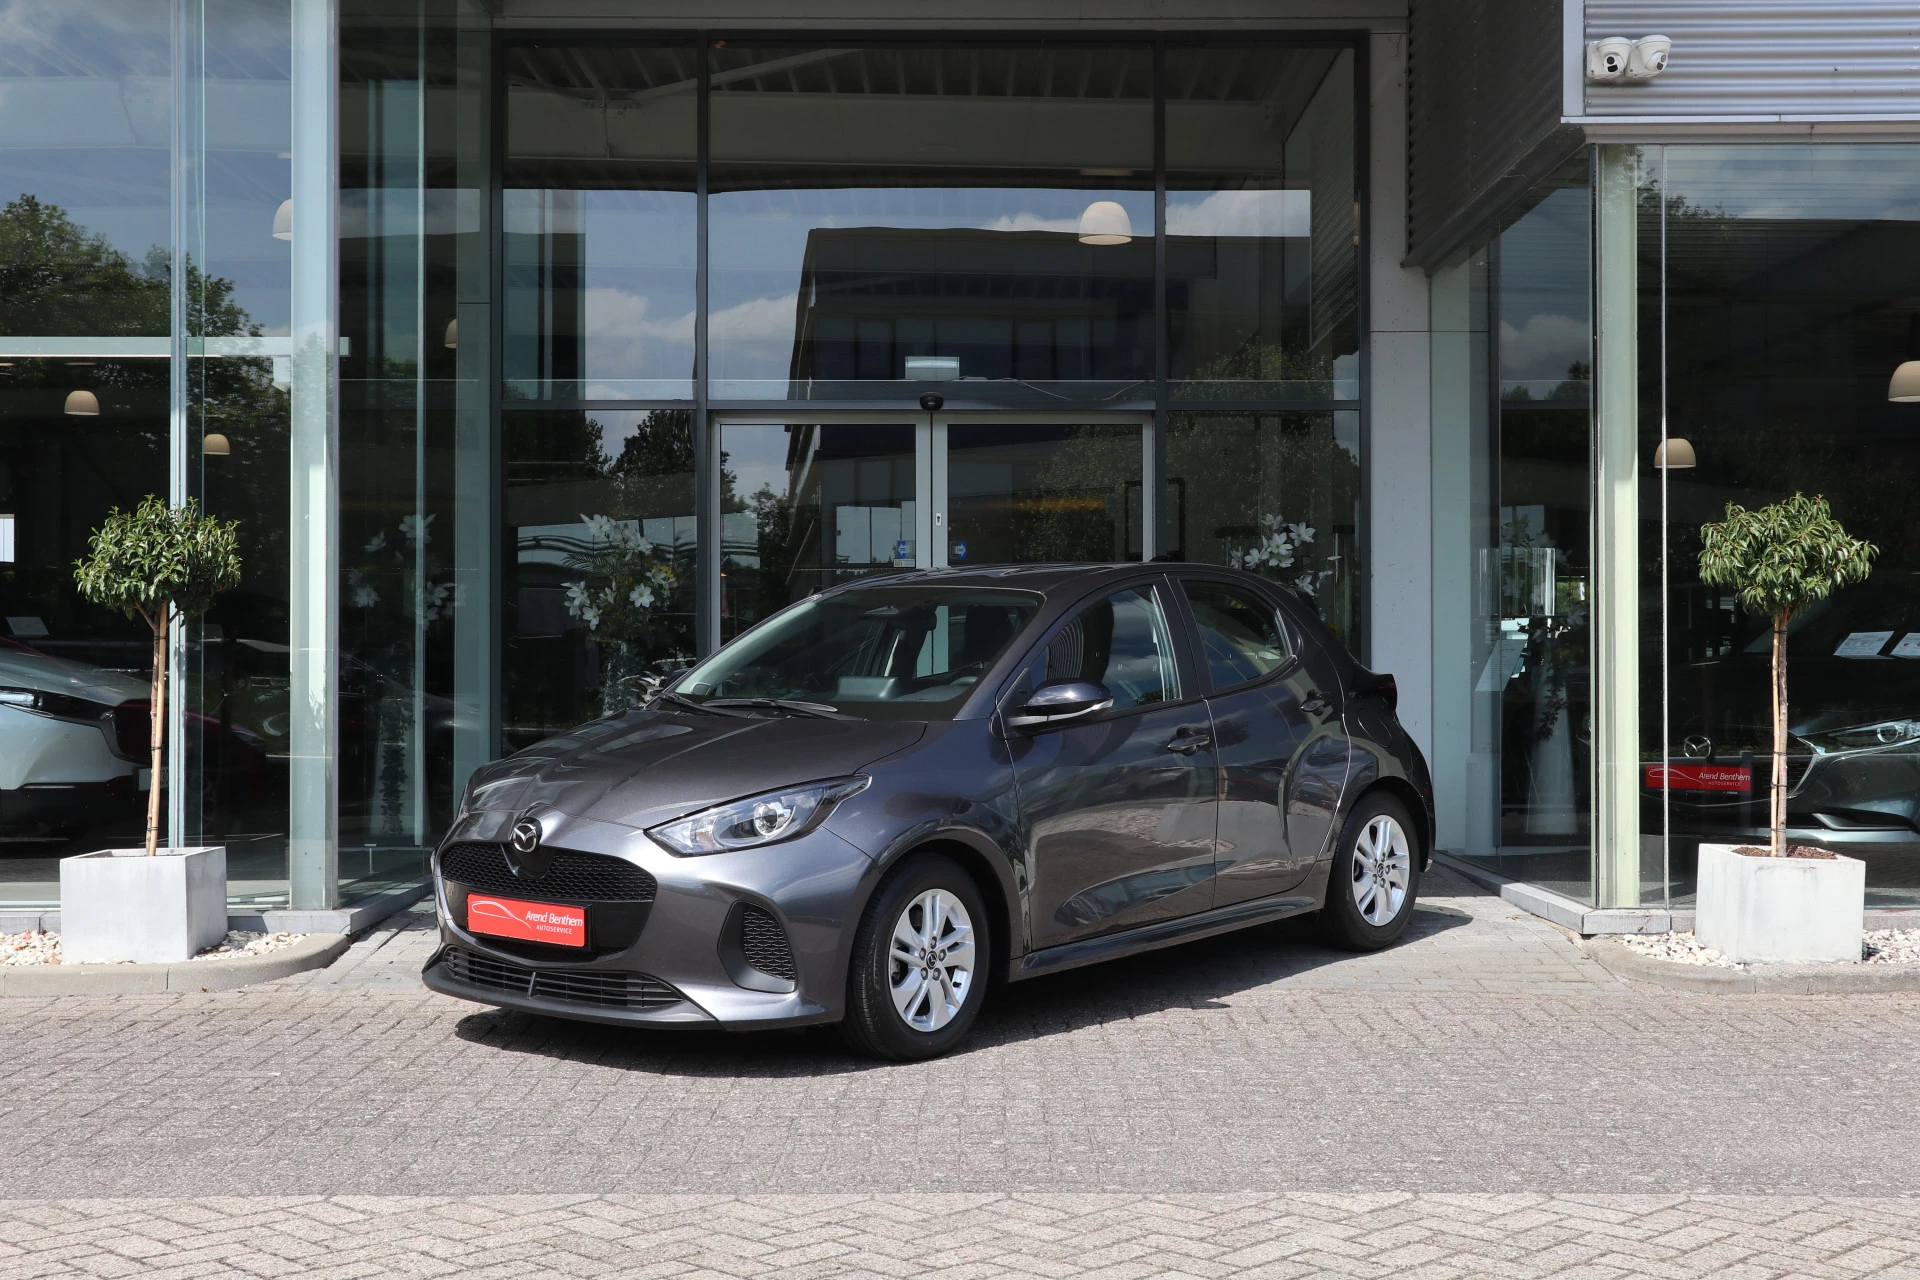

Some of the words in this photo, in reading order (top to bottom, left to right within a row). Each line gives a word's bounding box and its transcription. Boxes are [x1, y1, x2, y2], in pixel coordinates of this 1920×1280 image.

[1698, 772, 1719, 780] Arend
[525, 910, 548, 923] Arend
[548, 913, 583, 926] Benthem
[536, 924, 573, 934] AUTOSERVICE
